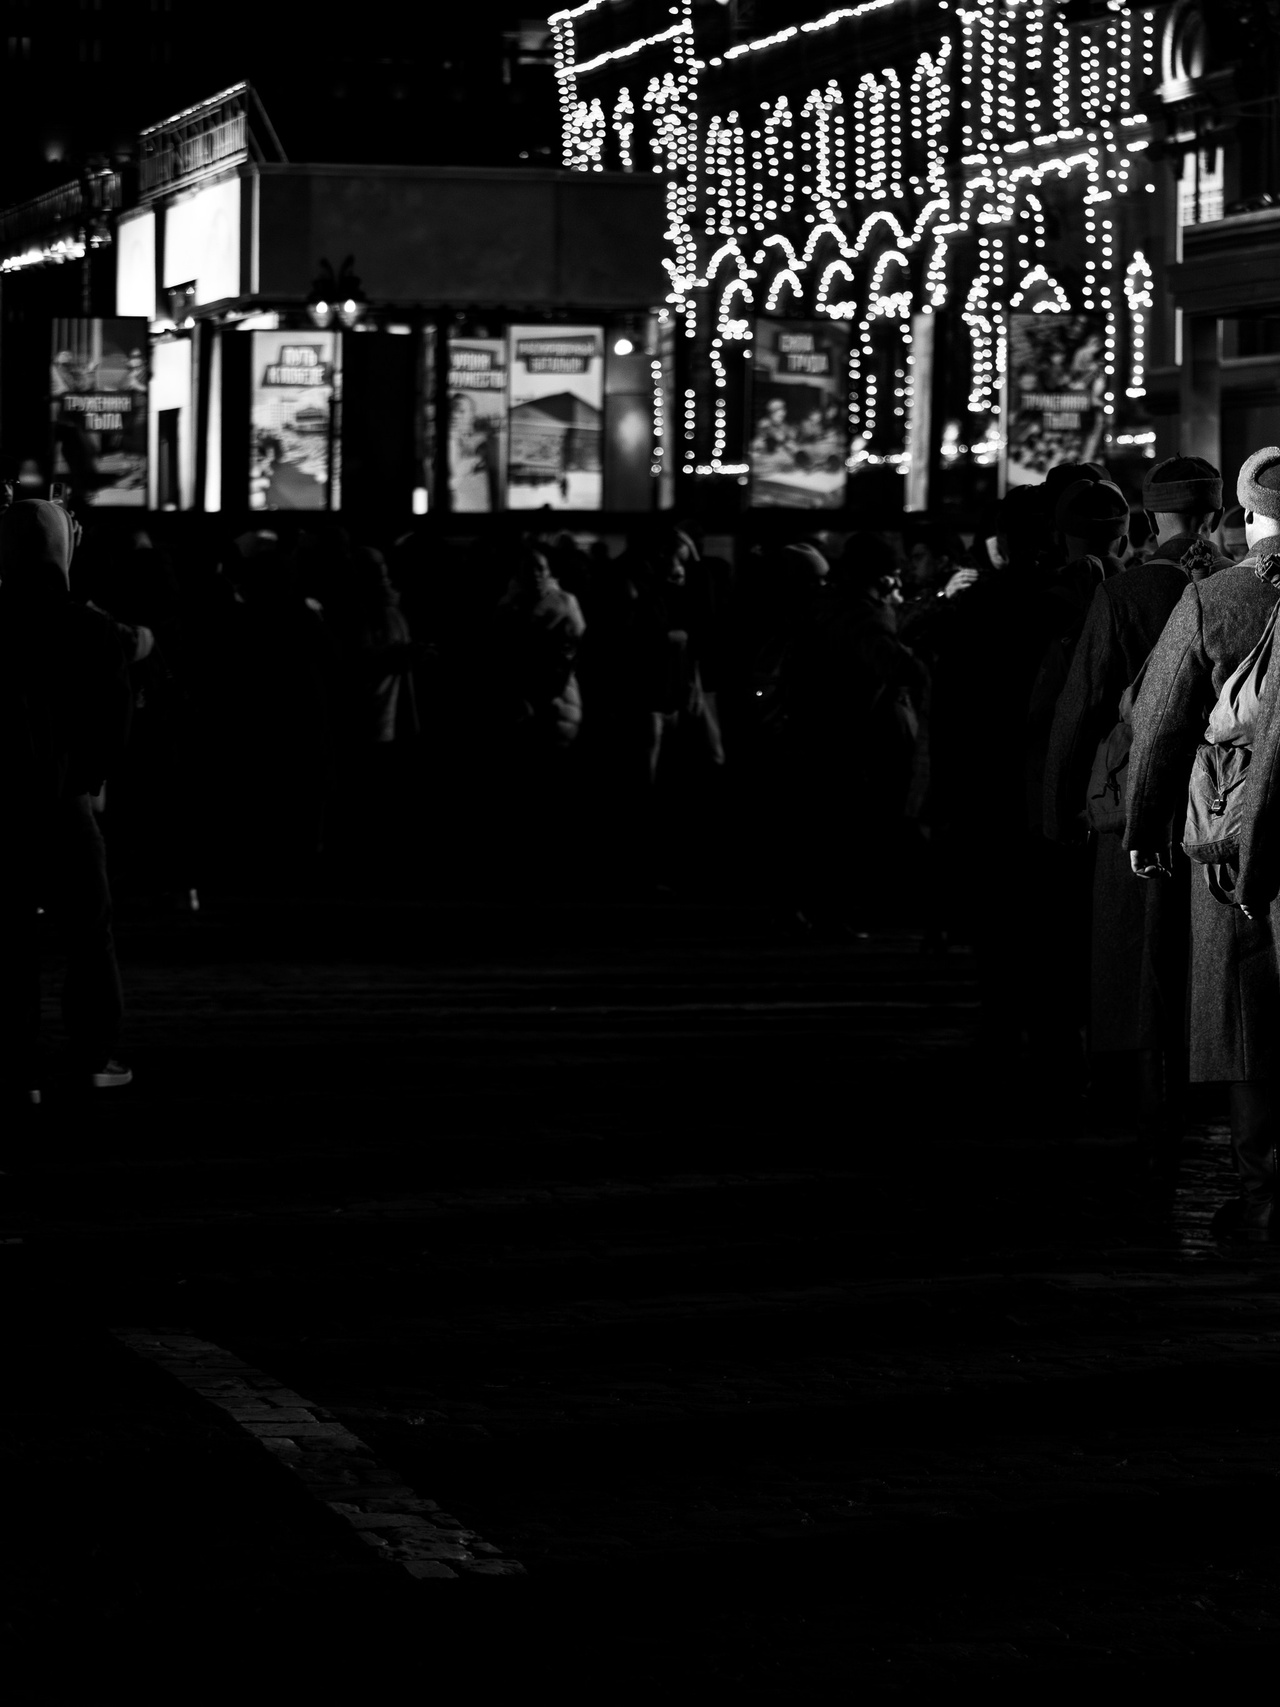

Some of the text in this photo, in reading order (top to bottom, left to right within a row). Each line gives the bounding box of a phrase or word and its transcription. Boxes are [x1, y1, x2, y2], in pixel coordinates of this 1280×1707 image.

[284, 348, 318, 366] ПУТЬ
[787, 349, 829, 373] ТРУДА
[281, 366, 325, 385] ПОБЕДЕ
[64, 396, 132, 412] ТРУЖЕНИКИ
[1021, 394, 1089, 411] ТРУЖЕНИКИ
[84, 412, 124, 430] ТЫЛА
[1043, 411, 1081, 430] ТЫЛА
